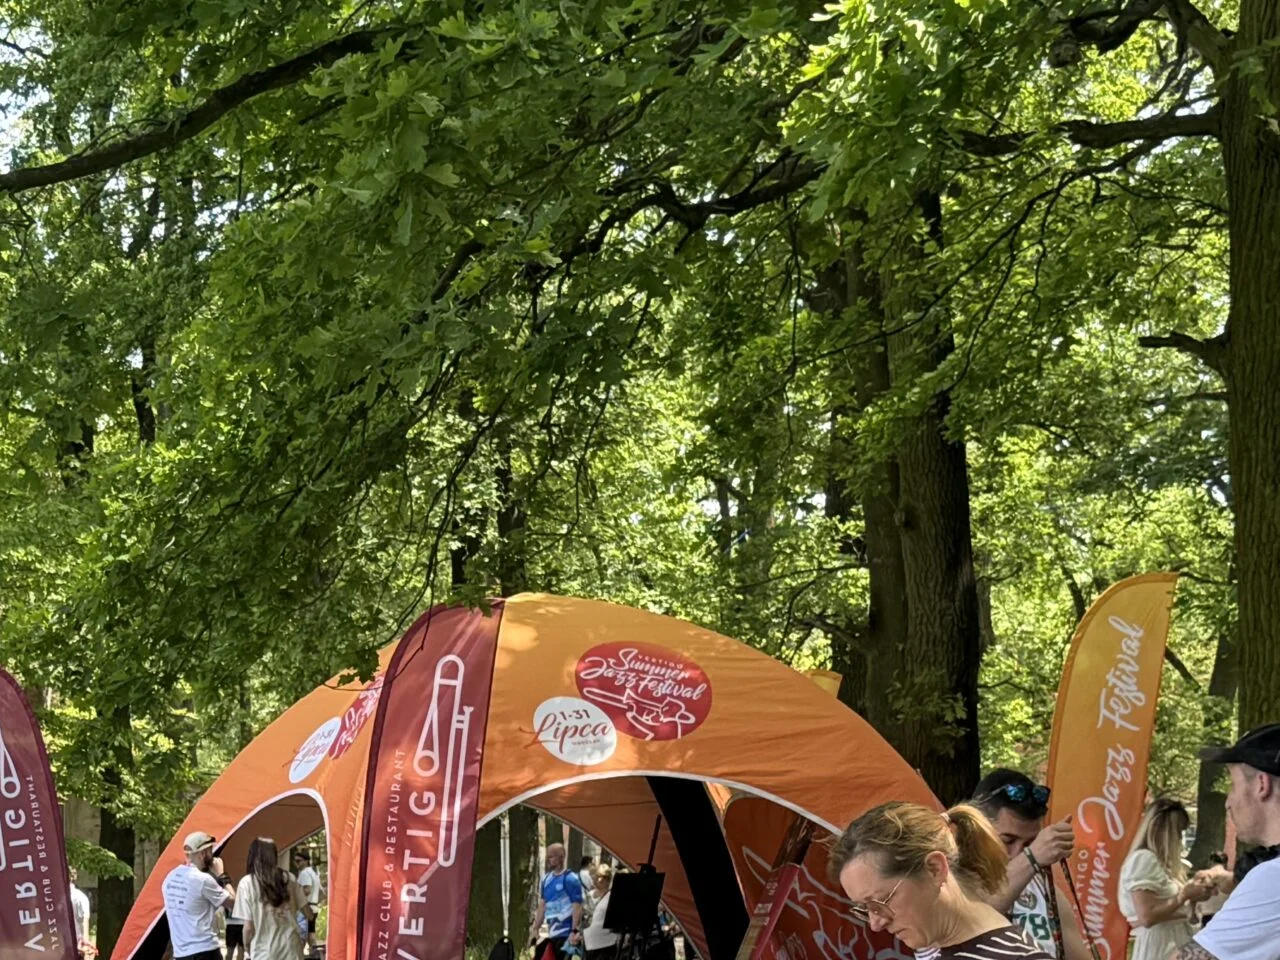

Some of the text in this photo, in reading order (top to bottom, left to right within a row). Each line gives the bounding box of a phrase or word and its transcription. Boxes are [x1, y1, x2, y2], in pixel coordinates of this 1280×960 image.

[580, 656, 708, 701] Jazz Festival
[607, 648, 690, 681] Summer
[1096, 614, 1146, 733] Festival
[523, 712, 610, 755] Lipca
[559, 708, 591, 721] 1-31
[387, 750, 406, 856] RESTAURANT
[1077, 742, 1136, 842] Jazz
[384, 864, 394, 875] &
[380, 880, 393, 921] CLUB
